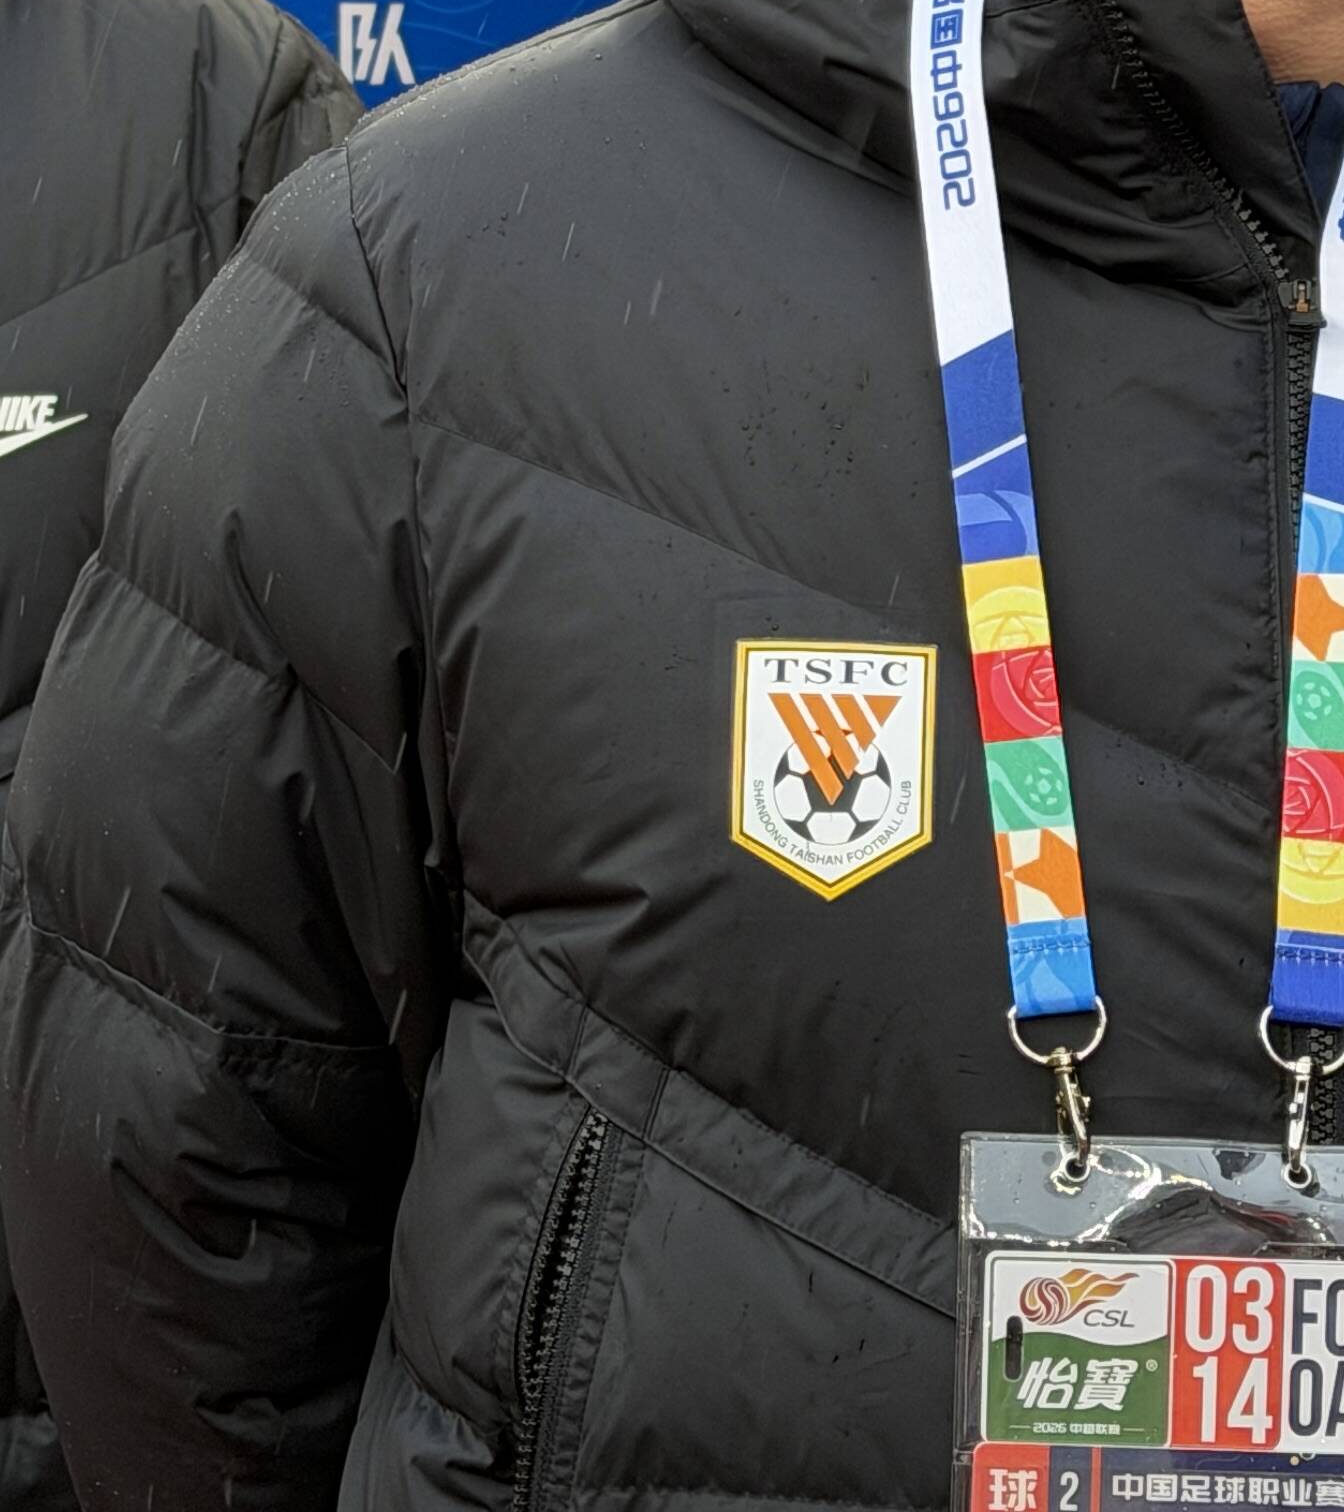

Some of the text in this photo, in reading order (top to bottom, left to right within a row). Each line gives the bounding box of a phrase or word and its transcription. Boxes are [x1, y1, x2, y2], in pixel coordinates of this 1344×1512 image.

[764, 658, 909, 687] TSFC
[753, 778, 913, 866] SHANDONG TAISHAN FOOTBALL CLUB
[1083, 1308, 1136, 1328] CSL
[1184, 1264, 1275, 1354] 03
[1017, 1357, 1139, 1412] 怡寶
[1192, 1355, 1274, 1445] 14
[1032, 1422, 1067, 1434] 2026
[1059, 1472, 1080, 1511] 2
